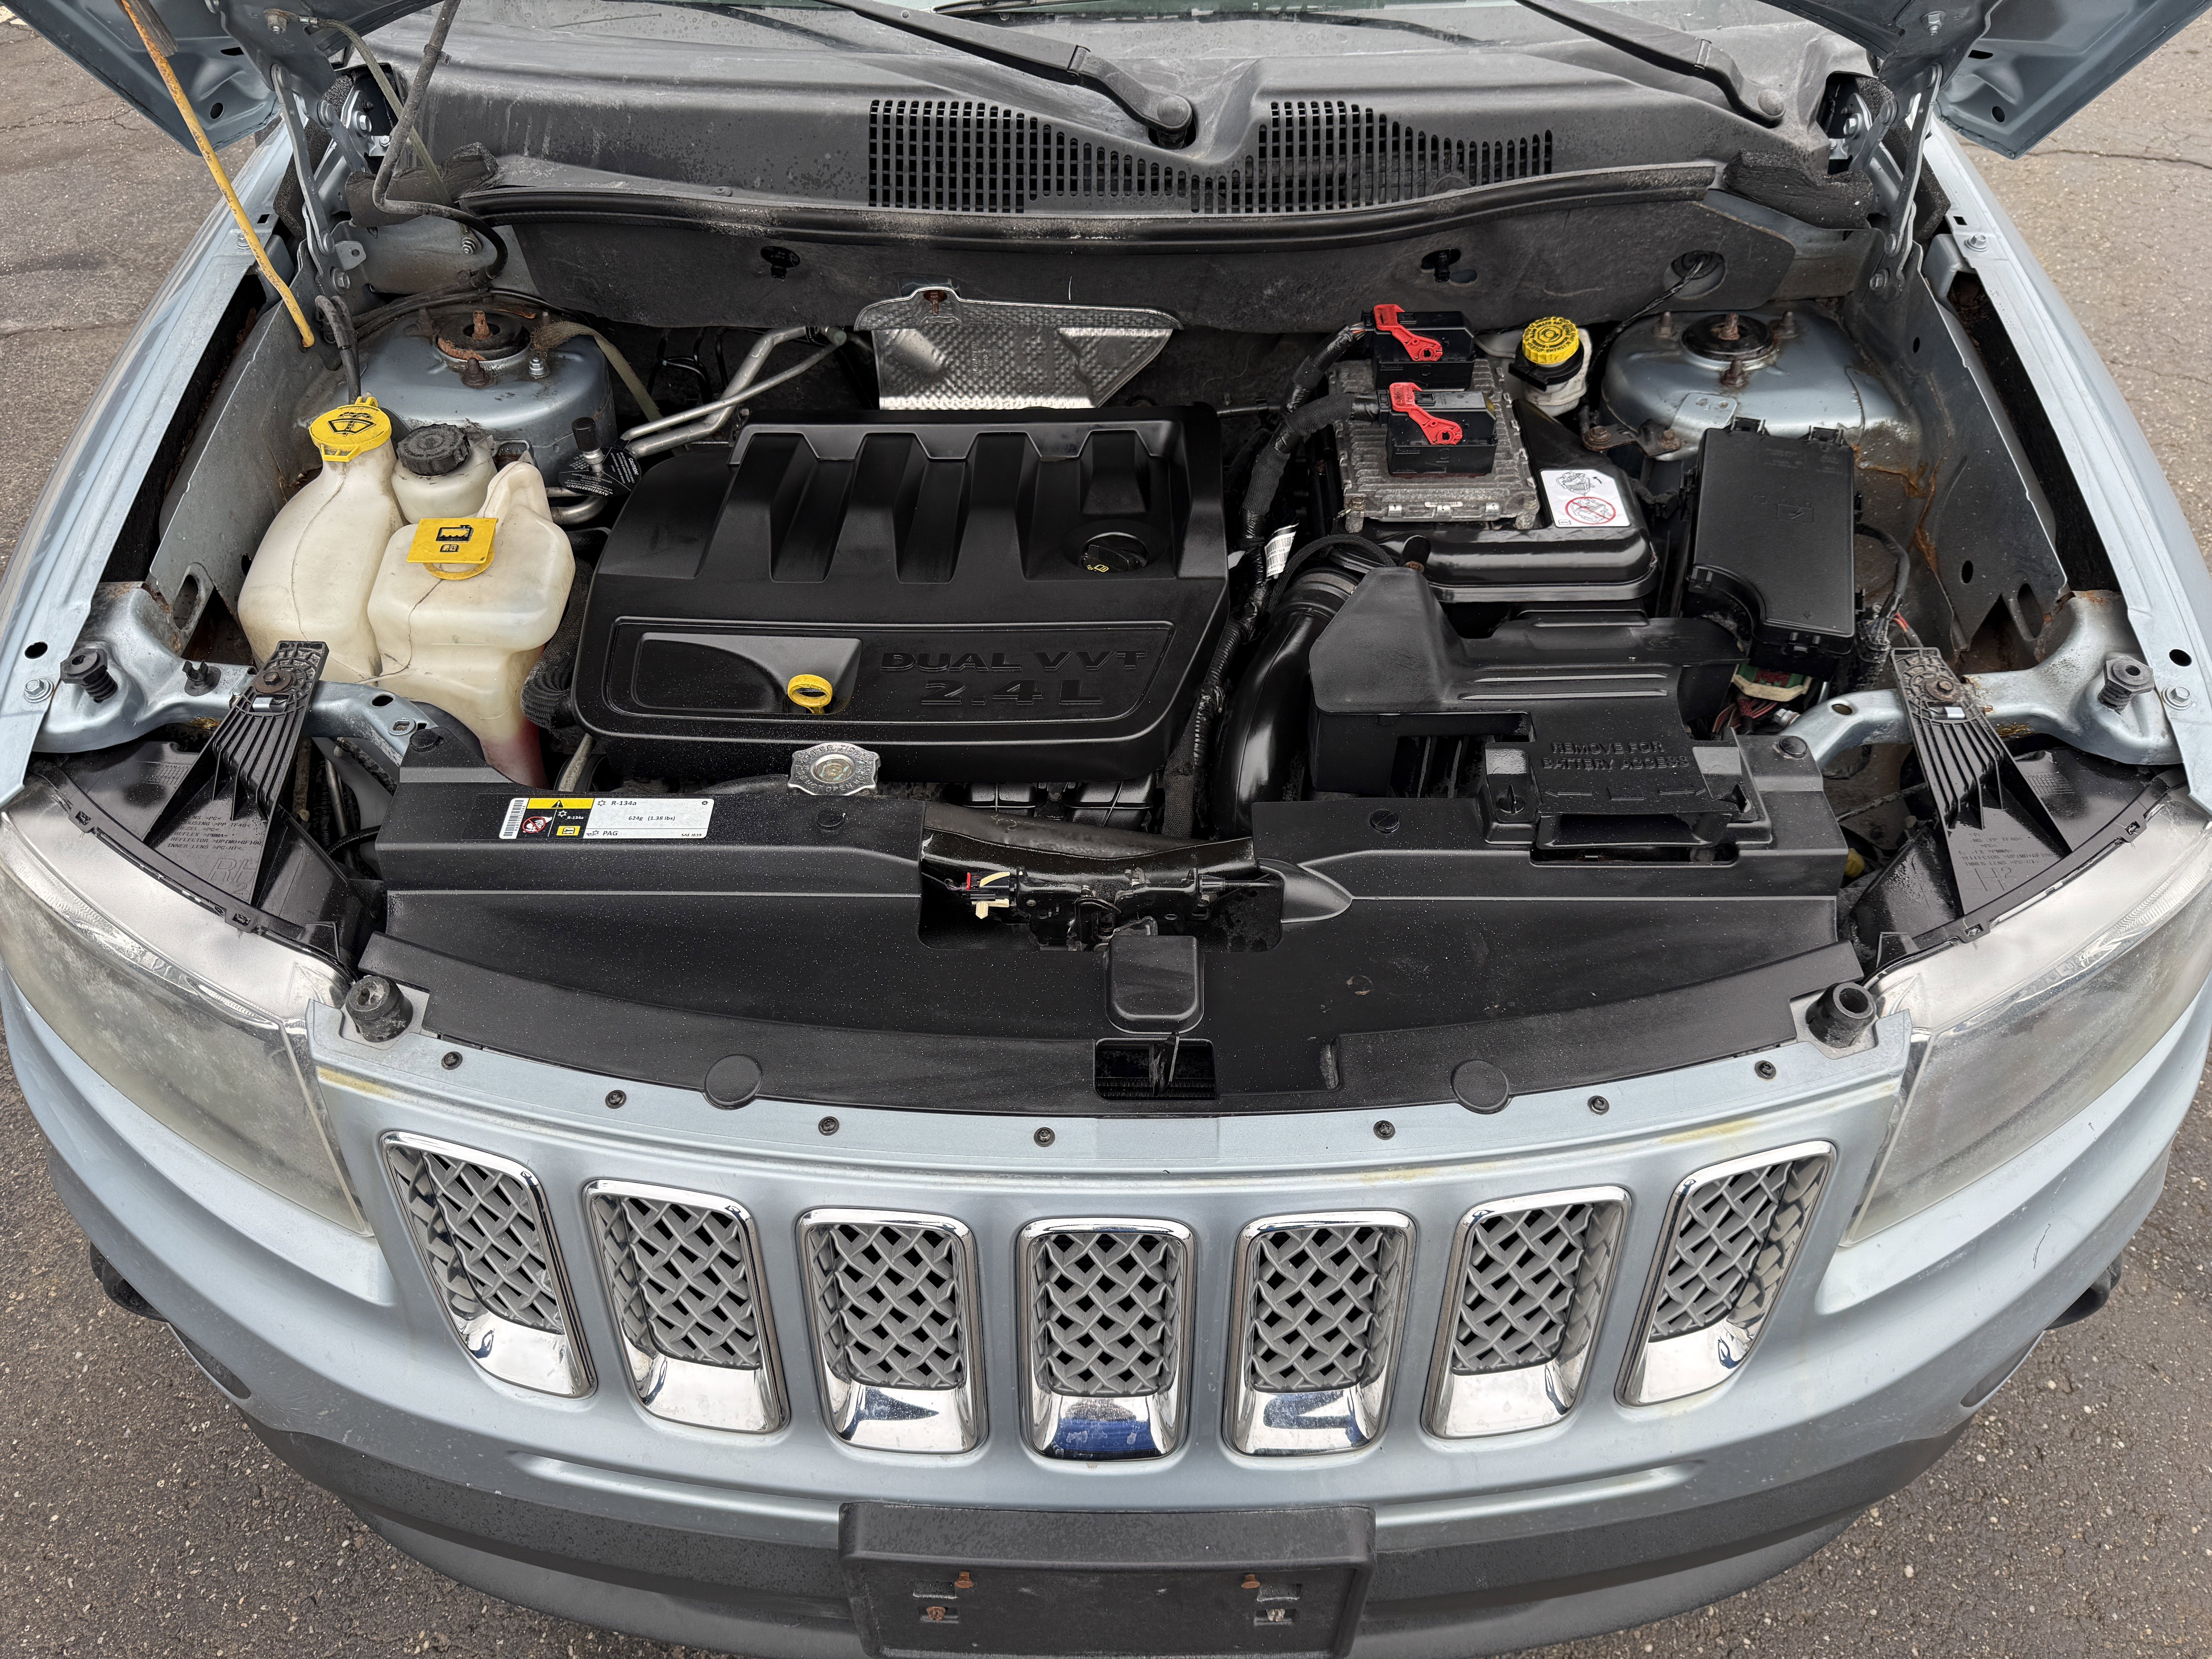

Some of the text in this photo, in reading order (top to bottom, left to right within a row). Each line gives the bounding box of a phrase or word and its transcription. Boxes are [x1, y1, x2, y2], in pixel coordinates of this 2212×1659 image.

[880, 651, 1147, 672] DUAL VVT
[921, 679, 1103, 705] 2.4 L
[1552, 741, 1664, 754] REMOVE FOR
[1542, 756, 1689, 770] BATTERY ACCESS
